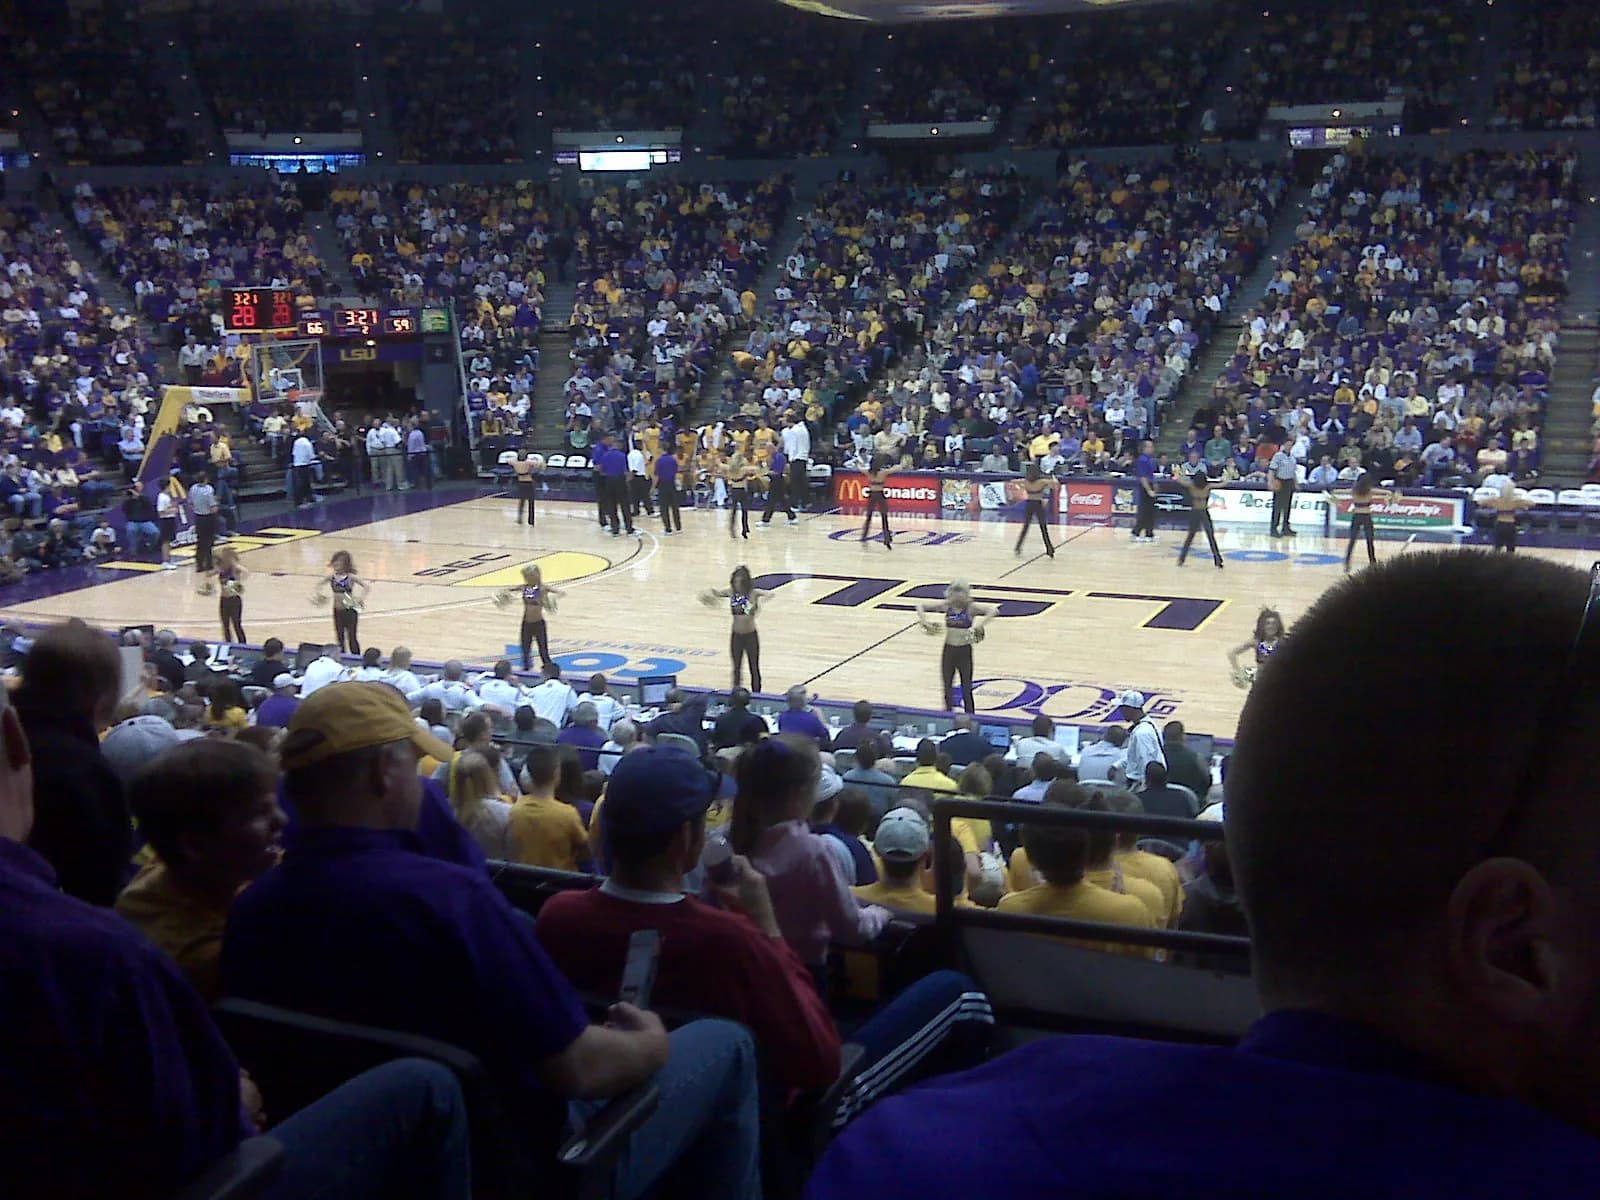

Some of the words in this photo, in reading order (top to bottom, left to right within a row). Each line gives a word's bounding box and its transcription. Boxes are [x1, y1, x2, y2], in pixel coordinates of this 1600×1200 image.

[232, 306, 256, 326] 28
[345, 310, 377, 326] 3:21
[393, 319, 410, 331] 59
[307, 322, 323, 334] 66
[341, 347, 376, 360] LSU
[839, 479, 937, 501] Mconald's
[1239, 491, 1329, 511] Acaian
[412, 552, 512, 578] SEC
[747, 572, 1232, 633] LSU
